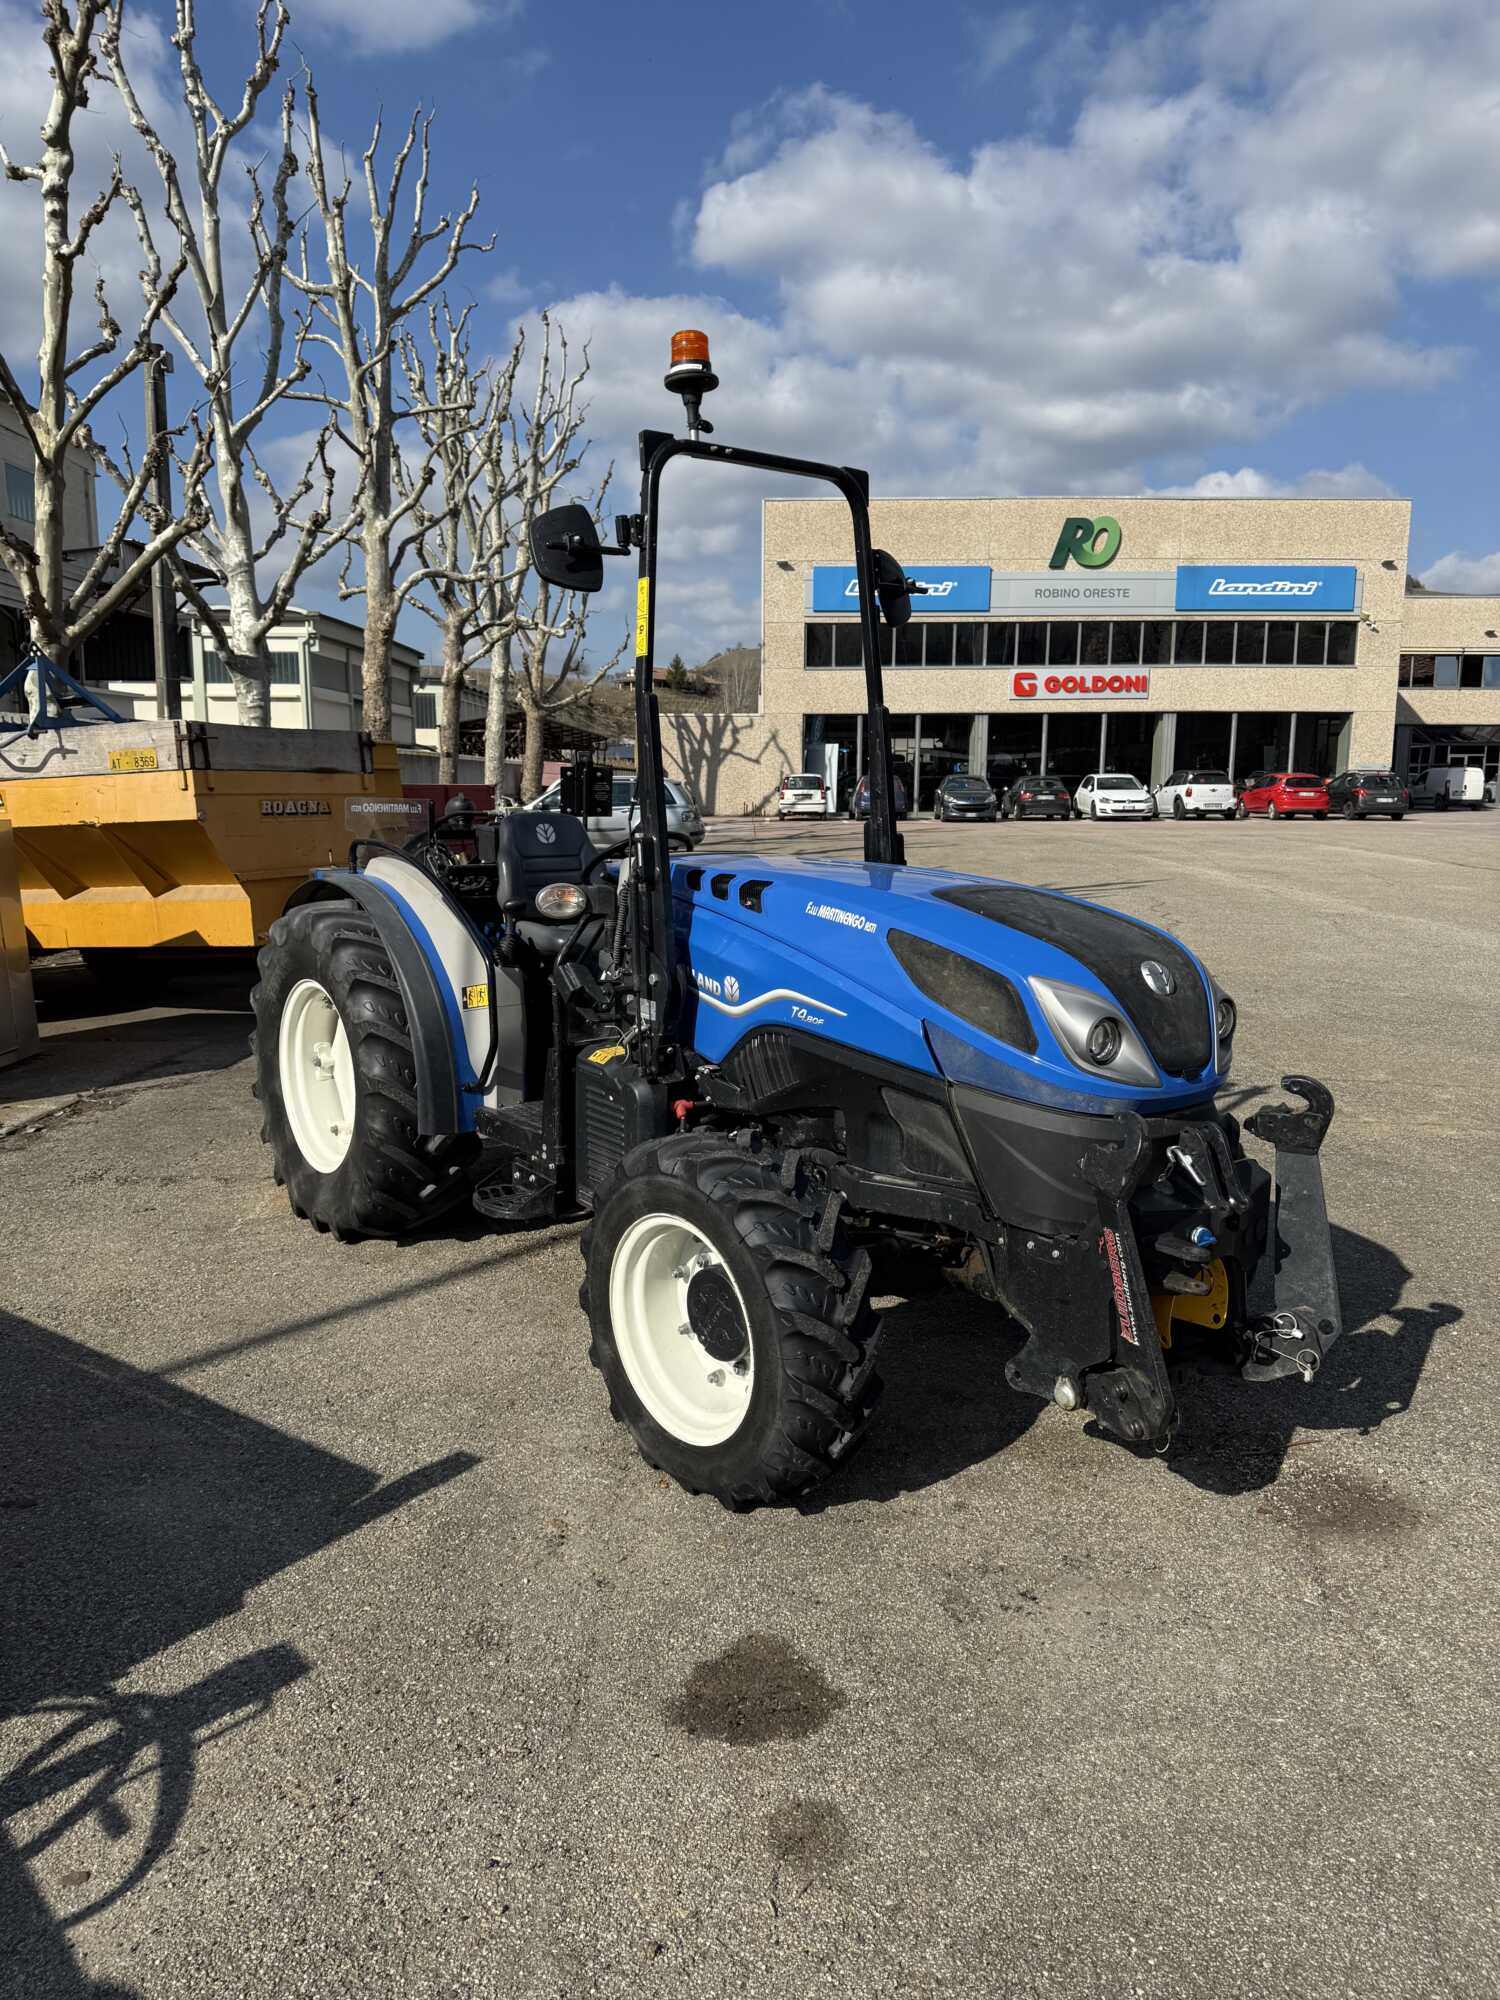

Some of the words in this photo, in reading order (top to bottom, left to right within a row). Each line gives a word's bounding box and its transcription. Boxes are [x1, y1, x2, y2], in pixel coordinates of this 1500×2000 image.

[1048, 515, 1122, 570] RO
[1034, 588, 1080, 599] ROBINO
[1083, 587, 1131, 598] ORESTE
[1044, 675, 1148, 694] GOLDONI
[134, 755, 155, 768] 8369
[260, 800, 332, 816] ROAGNA
[817, 904, 866, 929] MARTINENGO
[1103, 1226, 1134, 1344] ZUIDBERG
[1115, 1232, 1140, 1347] www.zuidberg.com
